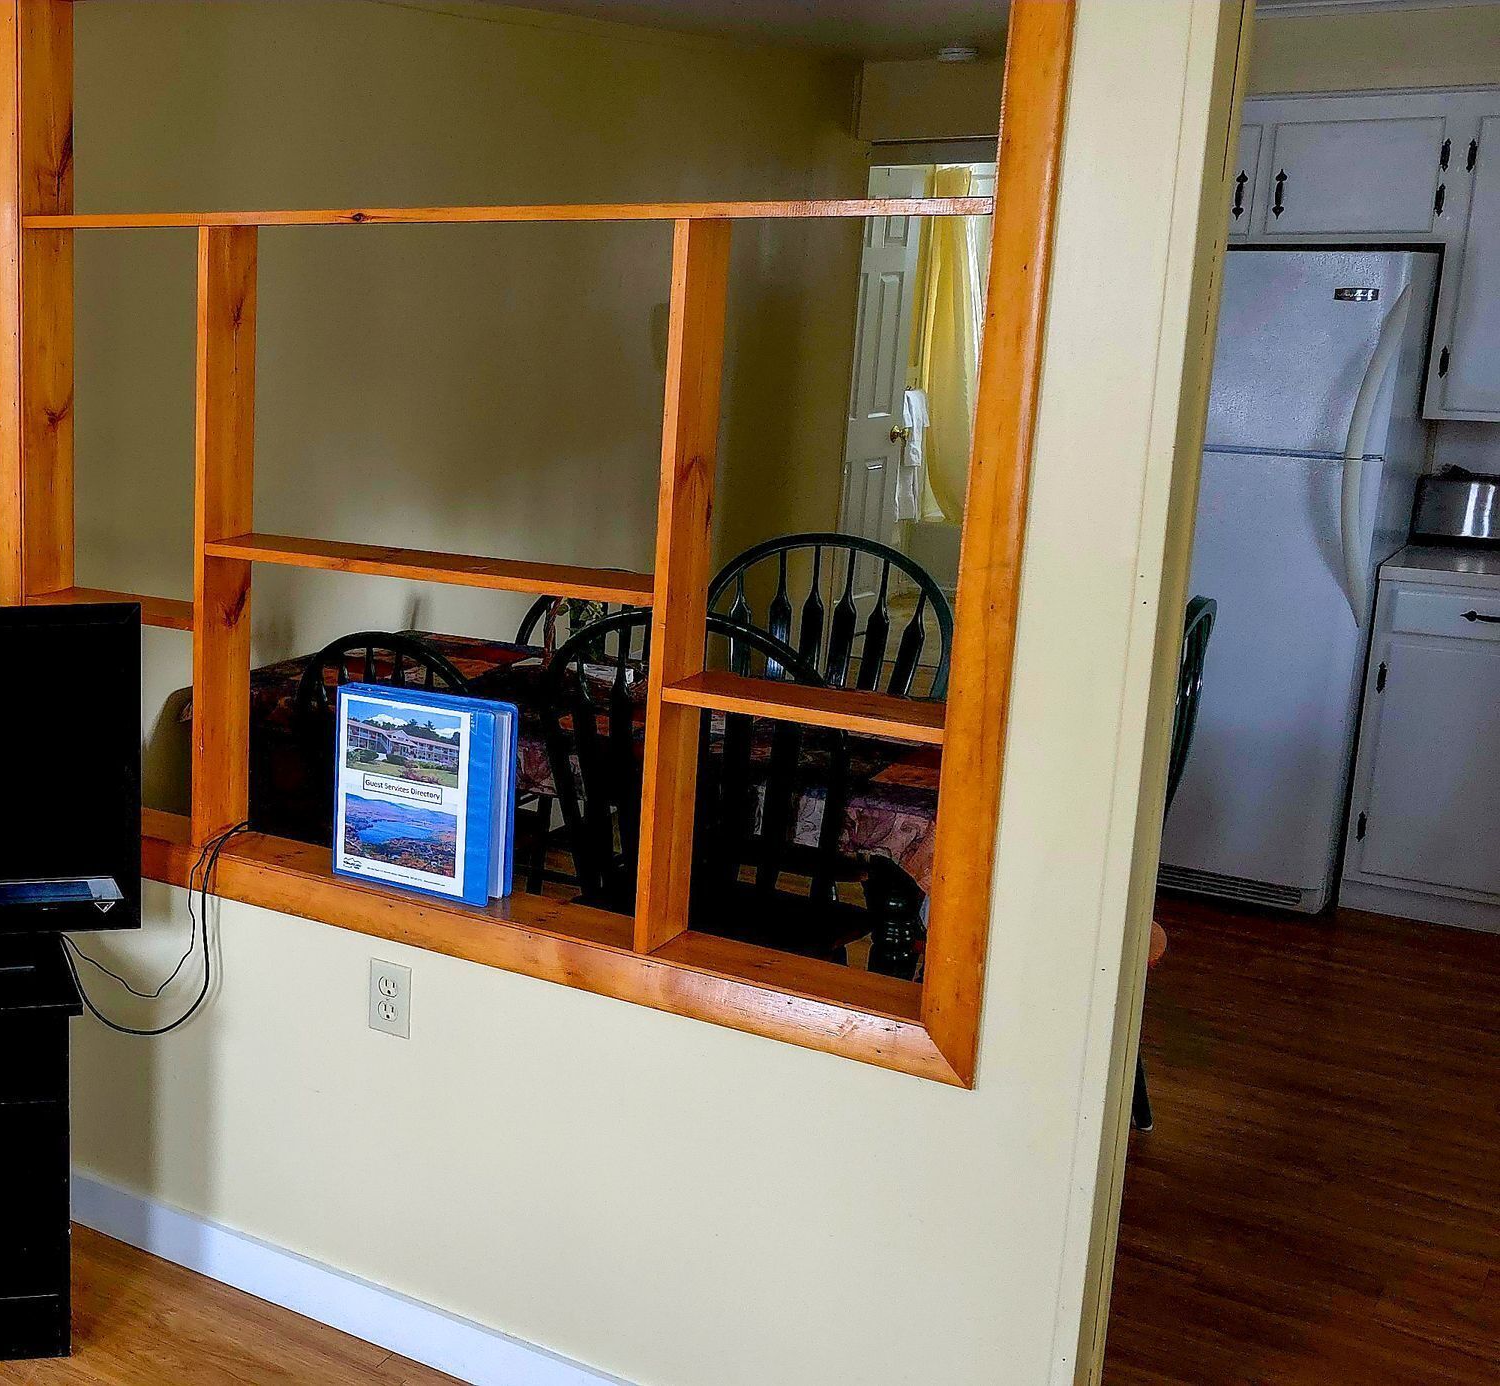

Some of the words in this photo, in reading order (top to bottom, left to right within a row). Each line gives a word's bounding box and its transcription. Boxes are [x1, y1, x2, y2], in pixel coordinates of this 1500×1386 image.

[365, 779, 383, 789] Guest
[384, 782, 410, 794] Services
[410, 787, 441, 800] Directory
